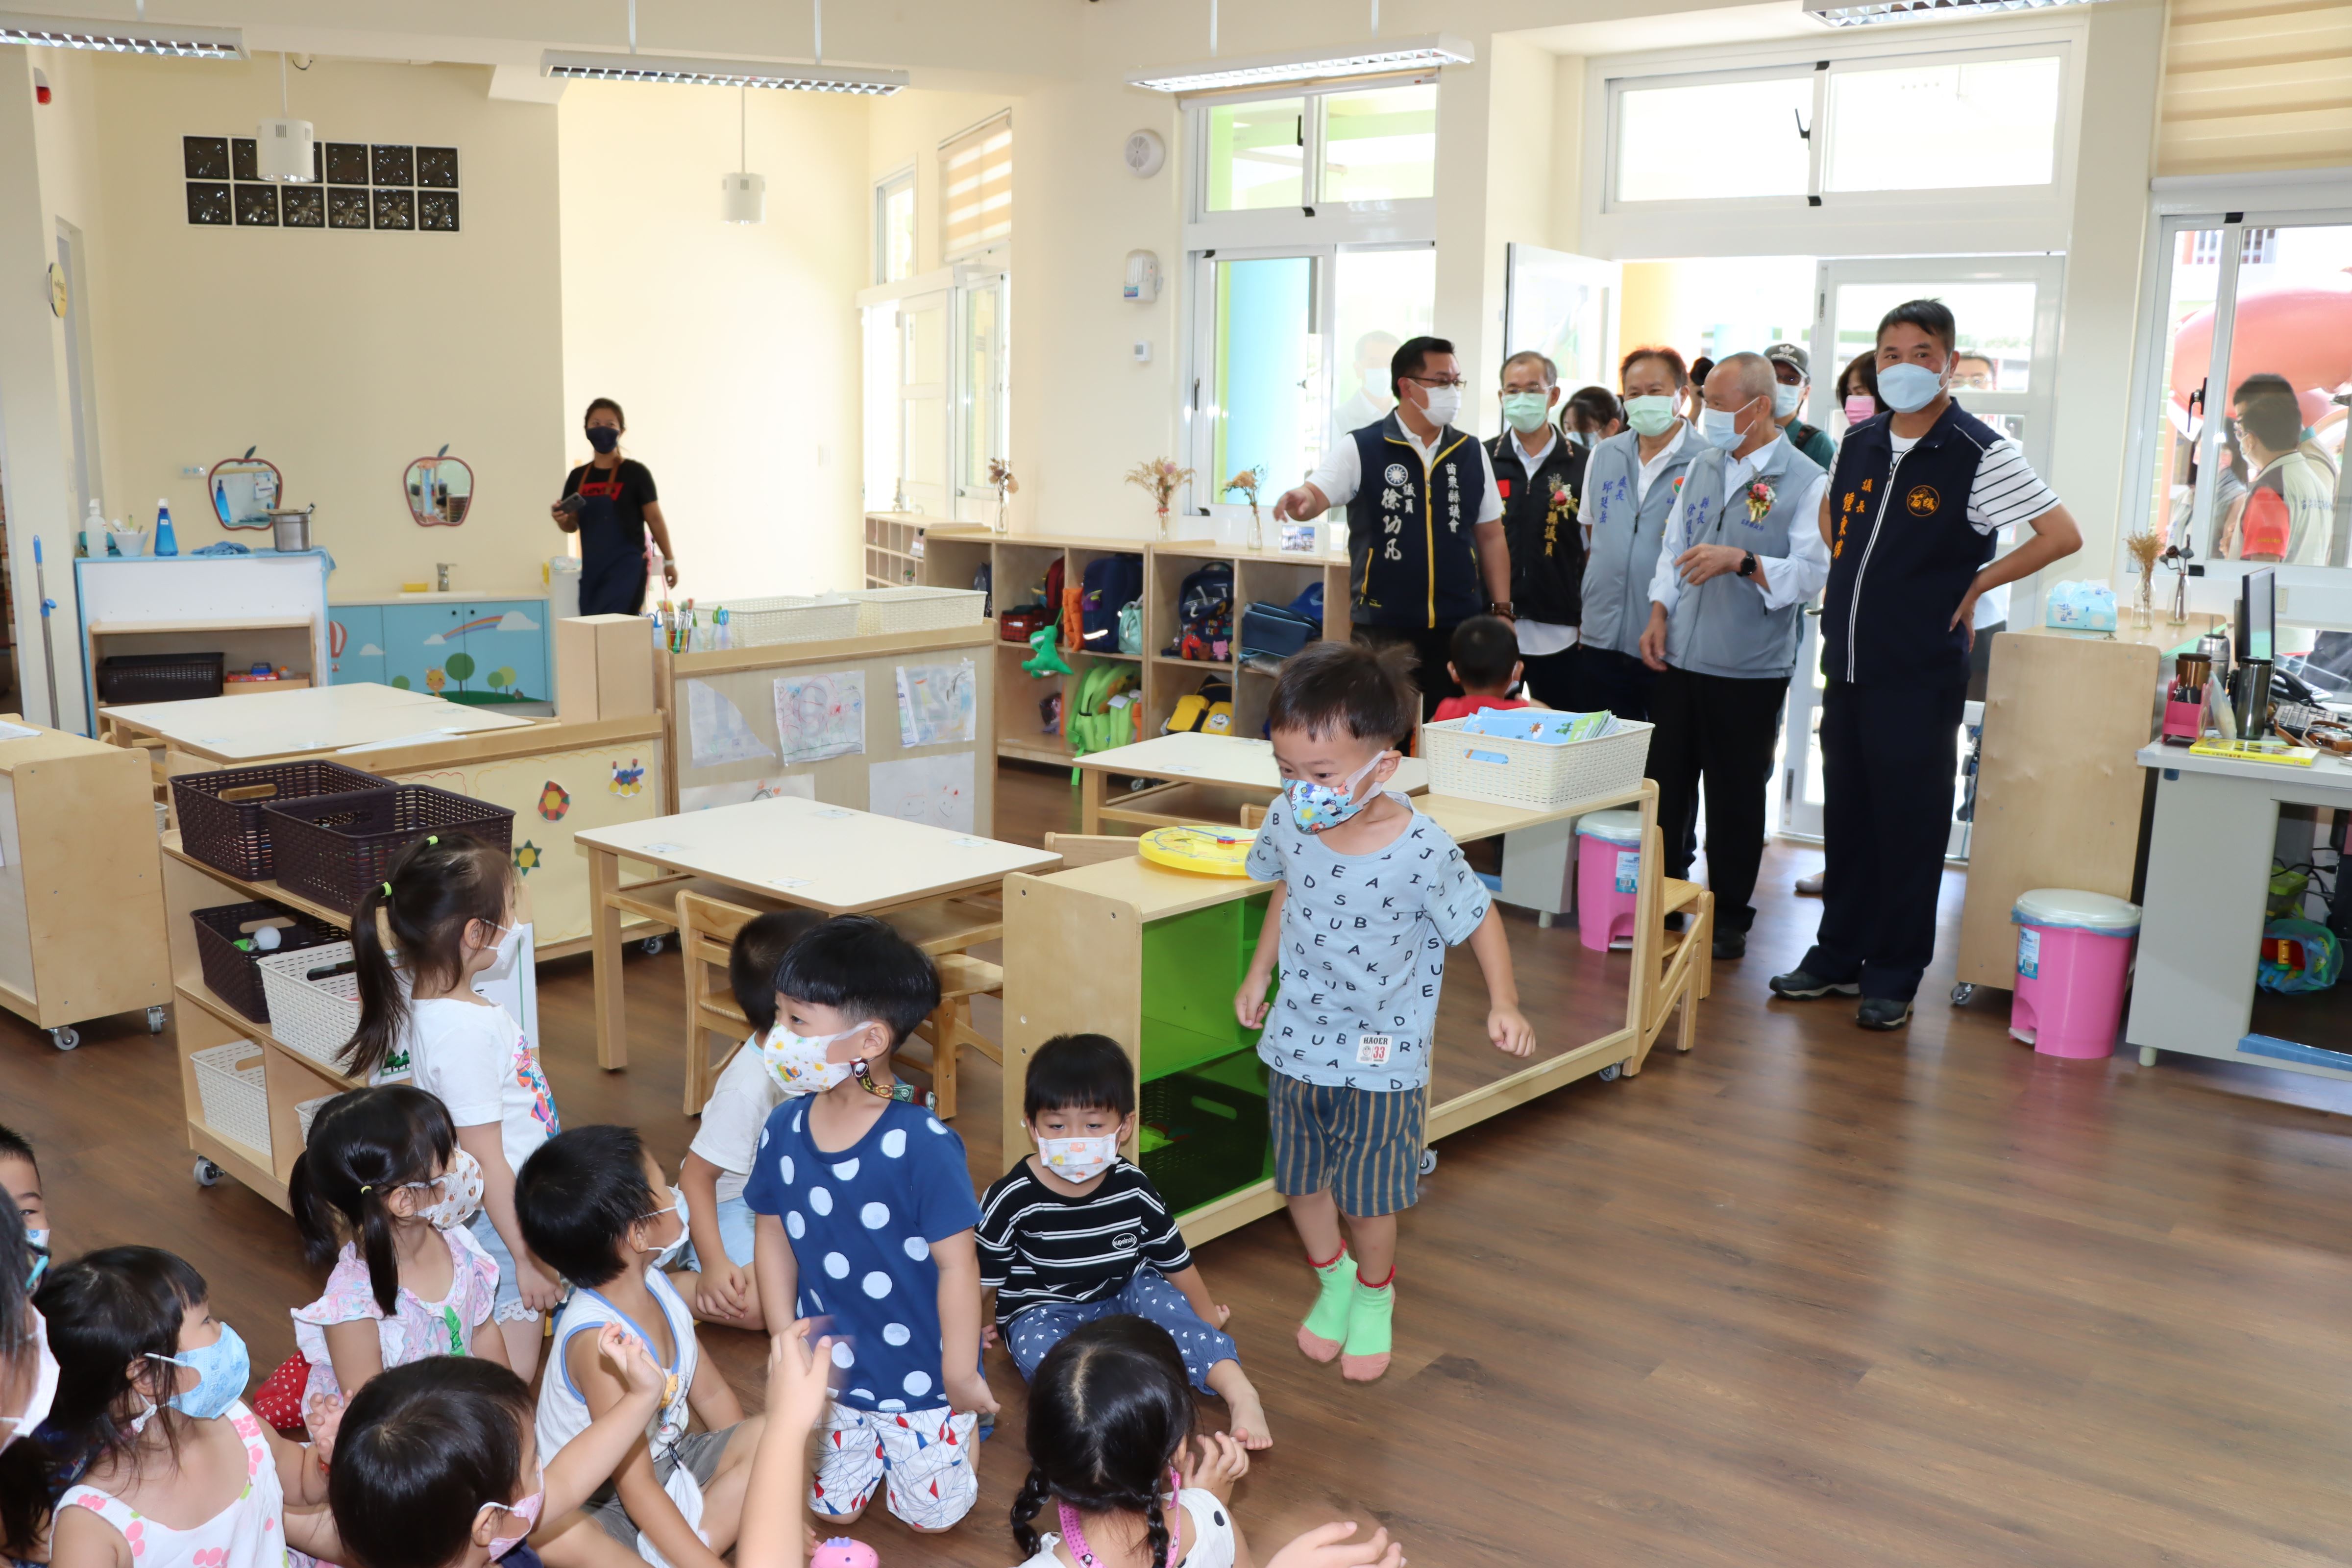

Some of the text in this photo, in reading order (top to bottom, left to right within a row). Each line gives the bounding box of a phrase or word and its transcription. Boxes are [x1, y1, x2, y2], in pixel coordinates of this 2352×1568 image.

[1771, 352, 1798, 362] adidas
[1402, 483, 1416, 514] 議員
[1445, 463, 1461, 533] 苗栗縣議會
[1856, 478, 1873, 513] 議長
[1273, 813, 1279, 825] B
[1411, 828, 1424, 839] K
[1294, 843, 1302, 855] I
[1420, 848, 1434, 859] J
[1331, 864, 1346, 878] E
[1304, 875, 1315, 888] D
[1365, 878, 1378, 888] A
[1410, 874, 1421, 883] I
[1334, 894, 1346, 905] S
[1382, 897, 1394, 908] K
[1303, 907, 1312, 920] R
[1330, 918, 1342, 930] U
[1354, 917, 1367, 928] B
[1315, 933, 1326, 947] E
[1391, 935, 1400, 946] I
[1427, 938, 1439, 949] S
[1296, 942, 1304, 955] D
[1348, 945, 1360, 955] A
[1323, 961, 1332, 970] S
[1366, 962, 1378, 972] K
[1431, 963, 1443, 975] U
[1298, 969, 1309, 980] R
[1378, 975, 1389, 985] J
[1346, 981, 1356, 991] B
[1422, 984, 1433, 997] E
[1311, 993, 1324, 1004] E
[1287, 999, 1297, 1010] D
[1378, 1000, 1386, 1011] I
[1316, 1016, 1327, 1025] S
[1358, 1020, 1369, 1030] K
[1394, 1016, 1405, 1026] D
[1282, 1027, 1293, 1037] R
[1312, 1034, 1324, 1045] U
[1336, 1033, 1347, 1045] B
[1373, 1046, 1386, 1059] 33
[1400, 1042, 1410, 1053] R
[1293, 1049, 1306, 1061] E
[1275, 1055, 1283, 1068] D
[1326, 1059, 1338, 1068] A
[1345, 1077, 1356, 1087] K
[1390, 1078, 1403, 1090] D
